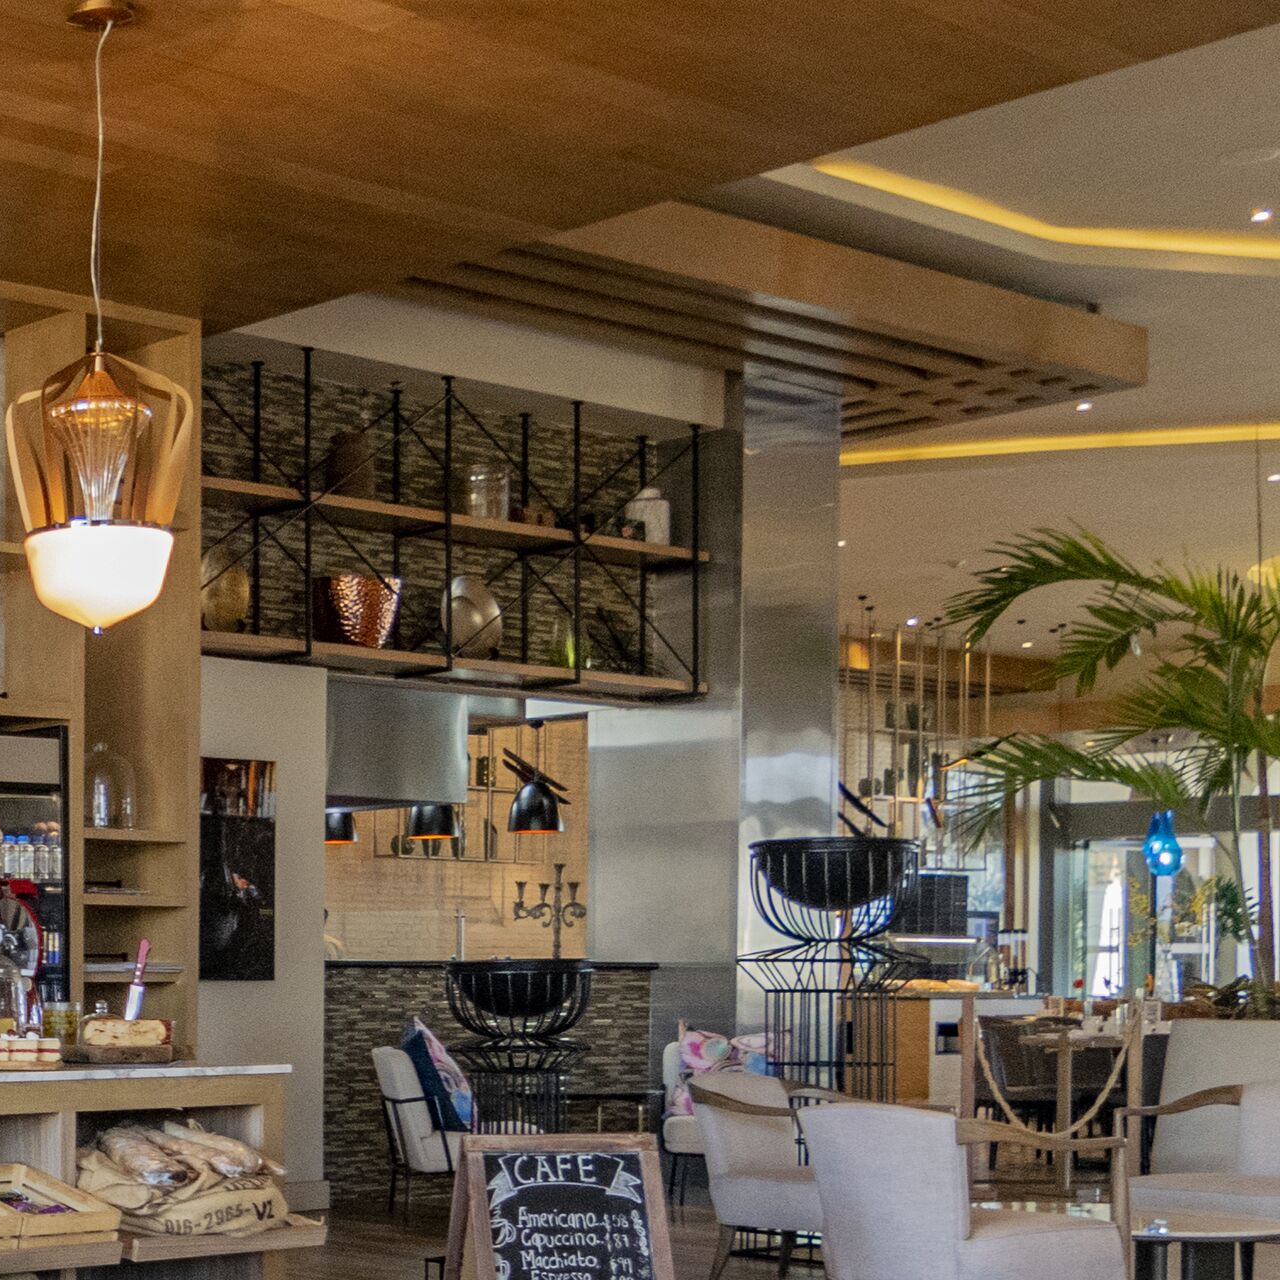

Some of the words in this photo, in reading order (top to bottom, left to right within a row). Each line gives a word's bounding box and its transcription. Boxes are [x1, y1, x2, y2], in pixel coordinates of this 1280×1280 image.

[513, 1154, 597, 1184] CAFE
[516, 1206, 597, 1230] Americano
[519, 1248, 598, 1271] Macchiato
